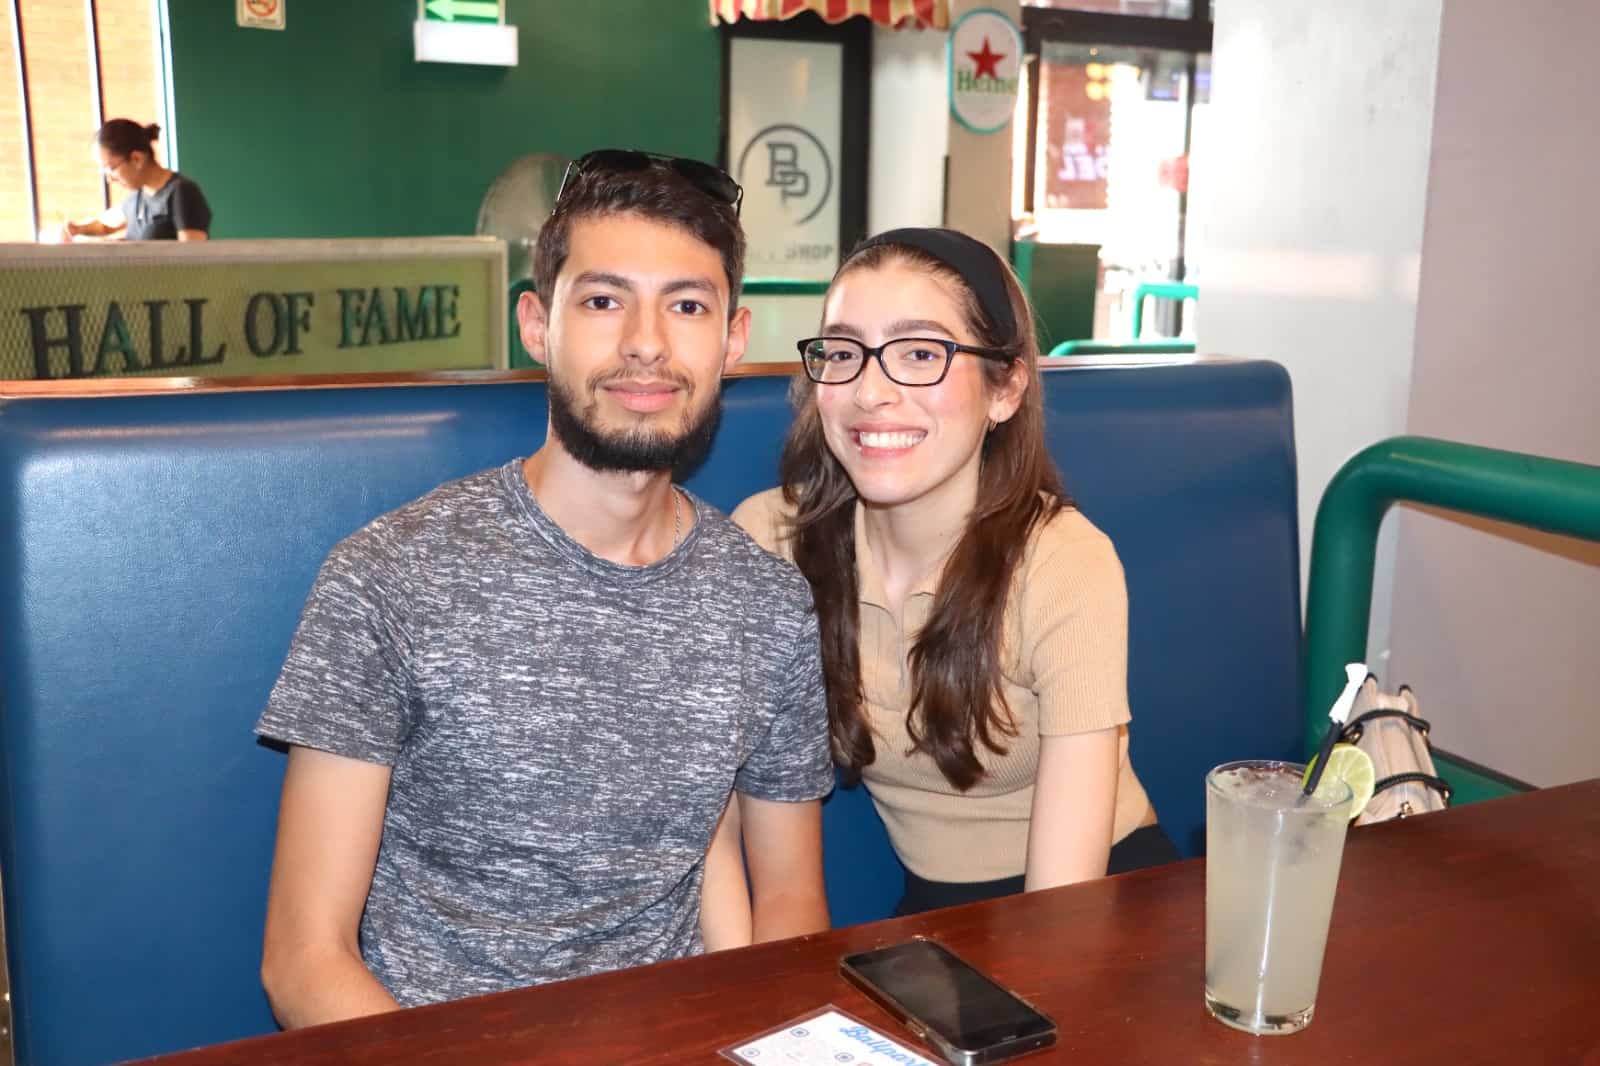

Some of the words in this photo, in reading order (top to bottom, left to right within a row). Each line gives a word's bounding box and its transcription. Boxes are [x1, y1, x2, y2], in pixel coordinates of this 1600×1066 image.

[20, 299, 227, 379] HALL
[244, 291, 315, 358] OF
[336, 284, 461, 349] FAME
[838, 1025, 930, 1066] Ballpar
